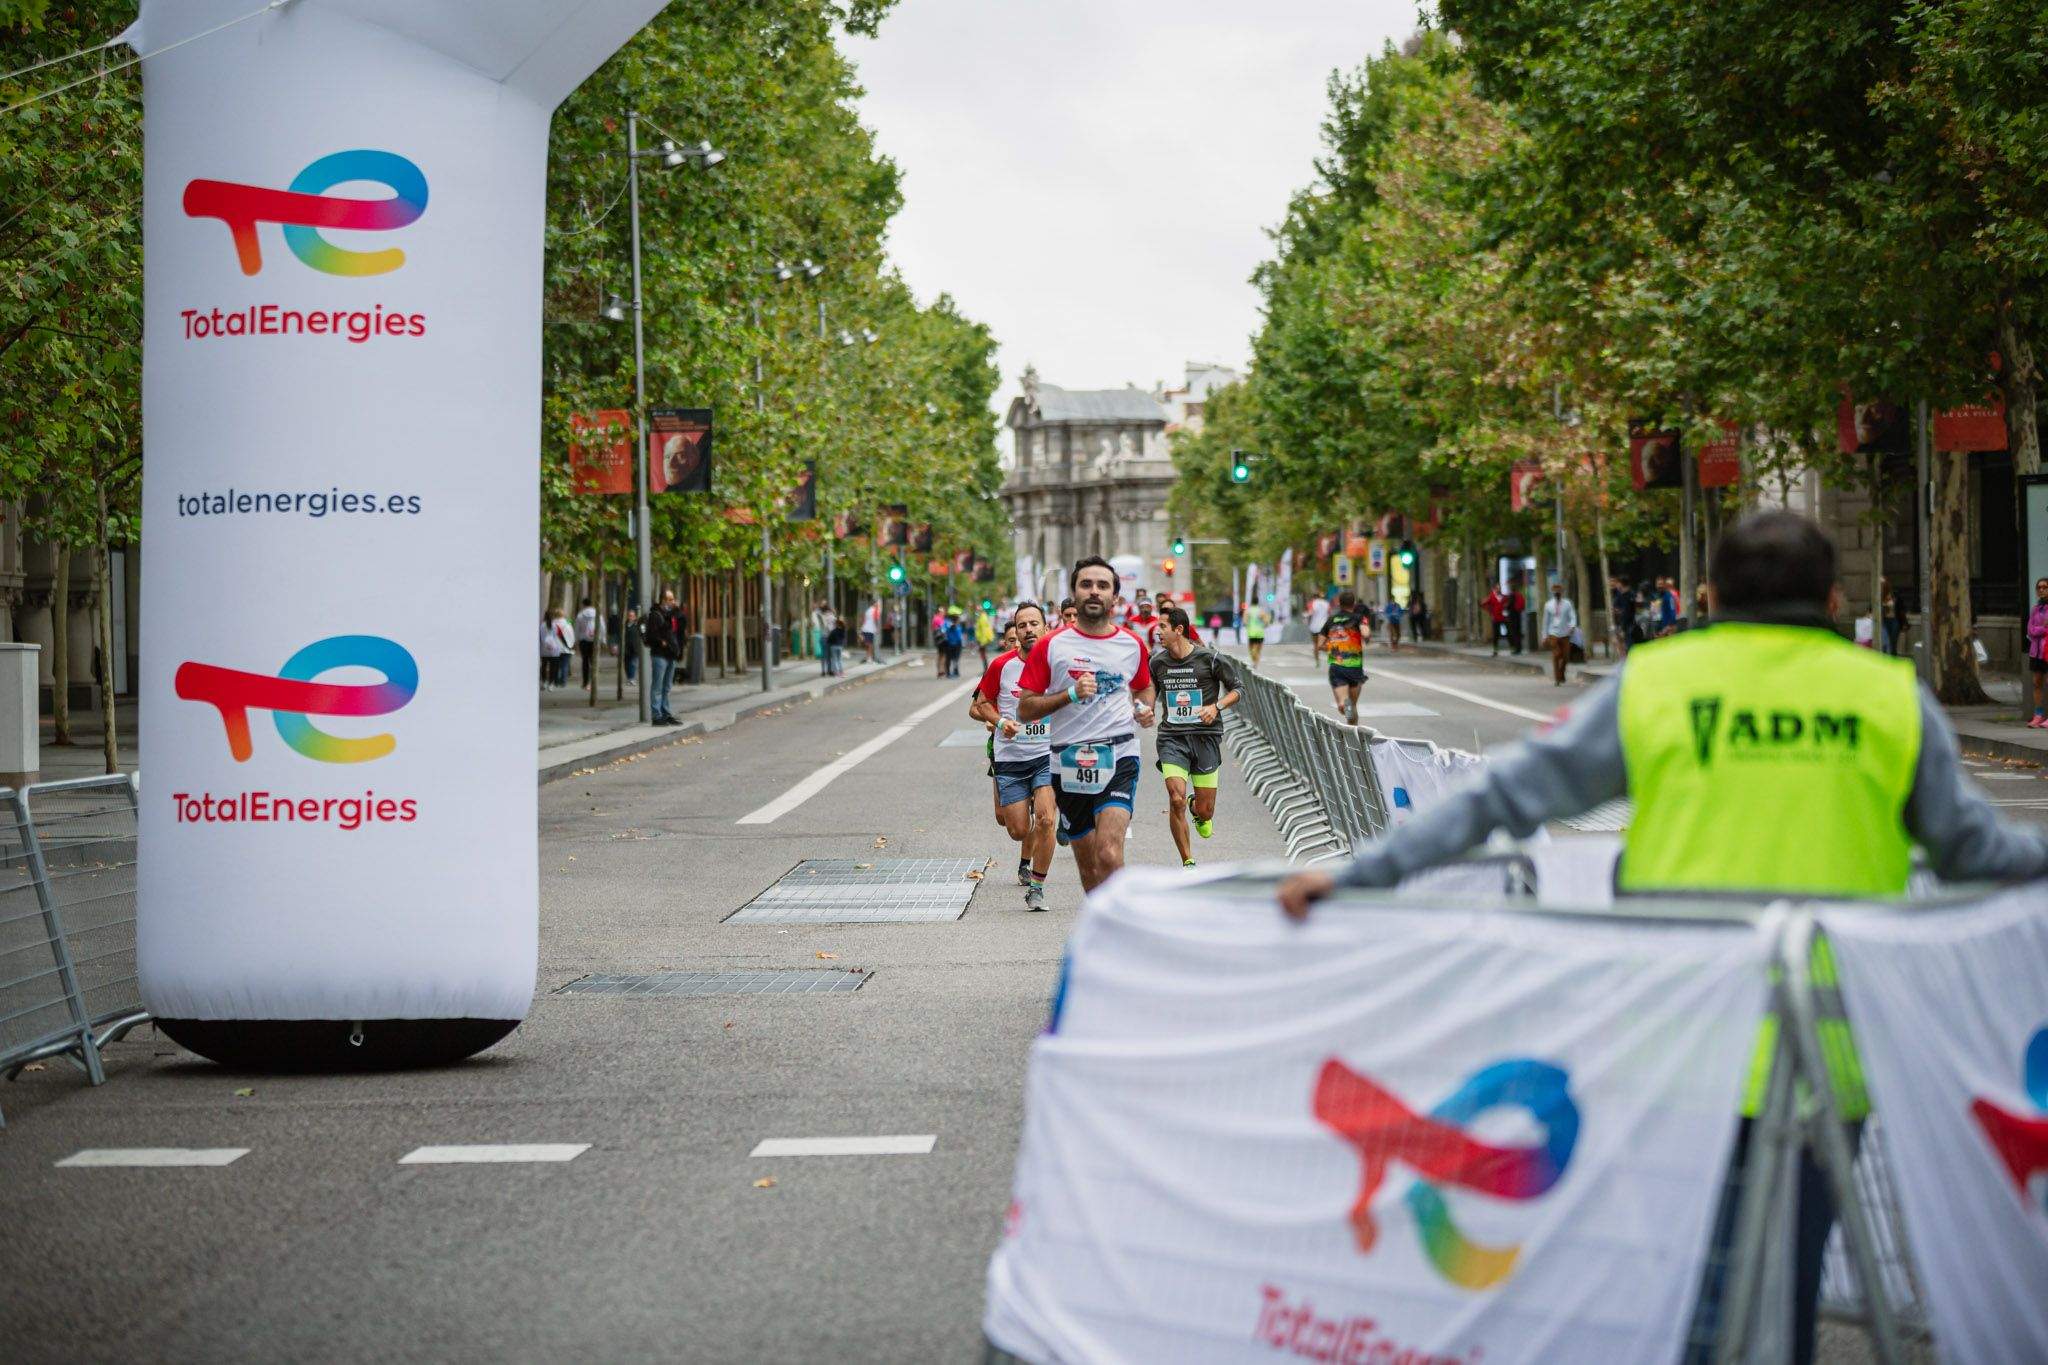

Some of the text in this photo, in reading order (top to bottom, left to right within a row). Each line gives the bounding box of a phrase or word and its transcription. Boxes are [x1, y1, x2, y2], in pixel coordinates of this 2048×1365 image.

[181, 303, 427, 344] TotalEnergies
[178, 487, 423, 518] totalenergies.es
[1176, 706, 1193, 717] 487
[1025, 724, 1046, 736] 508
[1076, 768, 1100, 784] 491
[173, 790, 418, 831] TotalEnergies
